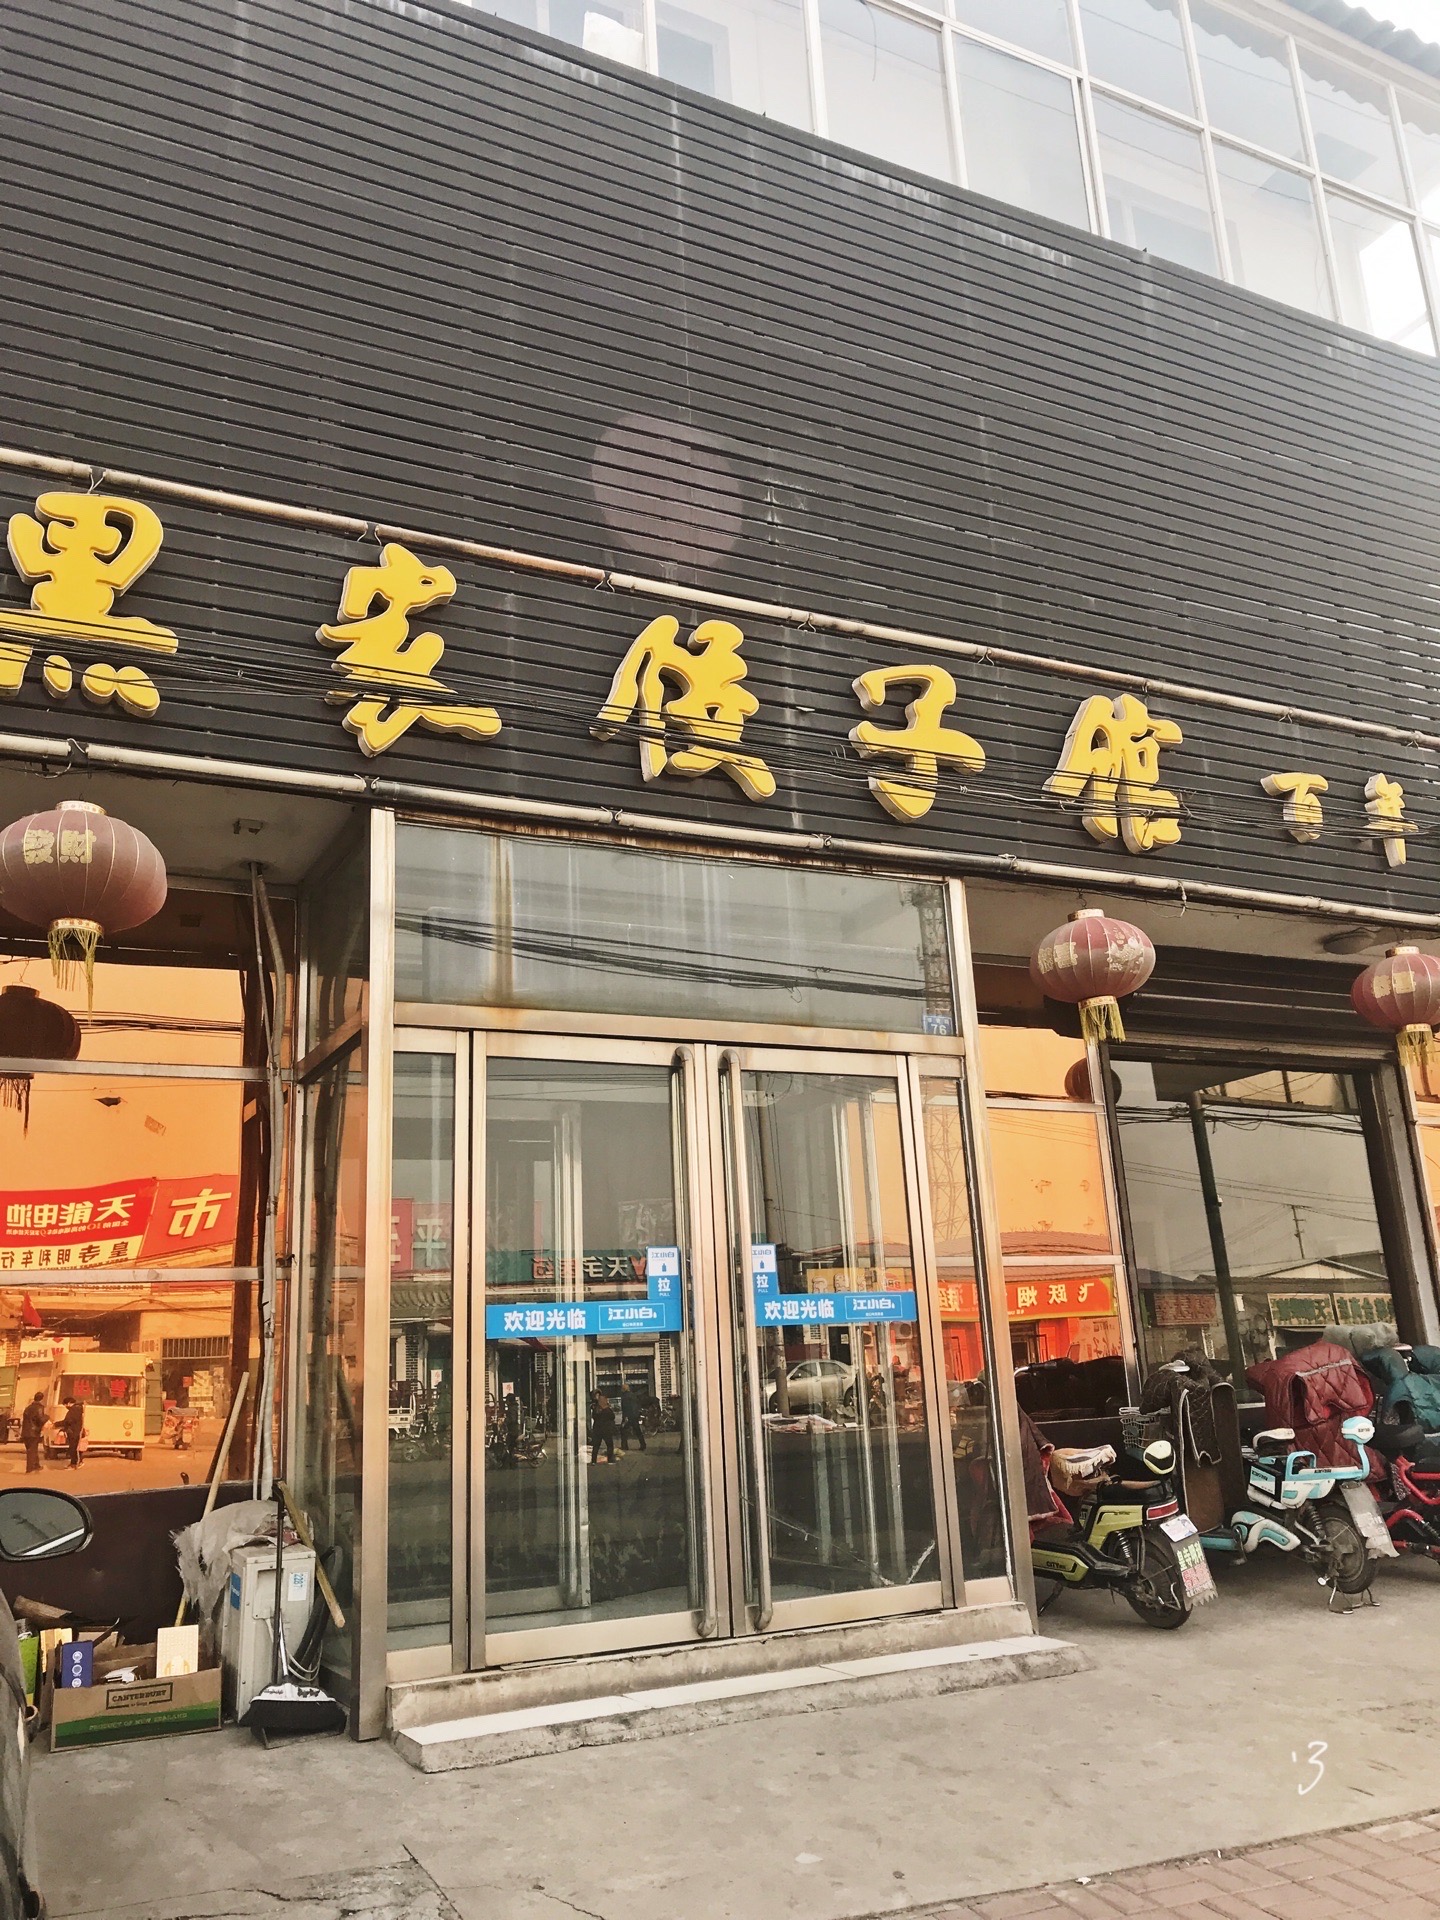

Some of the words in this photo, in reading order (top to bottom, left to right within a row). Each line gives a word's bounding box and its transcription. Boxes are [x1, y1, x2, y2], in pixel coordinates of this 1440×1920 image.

[930, 1023, 947, 1036] 76
[657, 1277, 671, 1292] 拉
[756, 1274, 769, 1289] 拉
[763, 1299, 835, 1321] 欢迎光临
[853, 1298, 892, 1311] 江小白
[503, 1307, 586, 1332] 欢迎光临
[608, 1306, 652, 1321] 江小白
